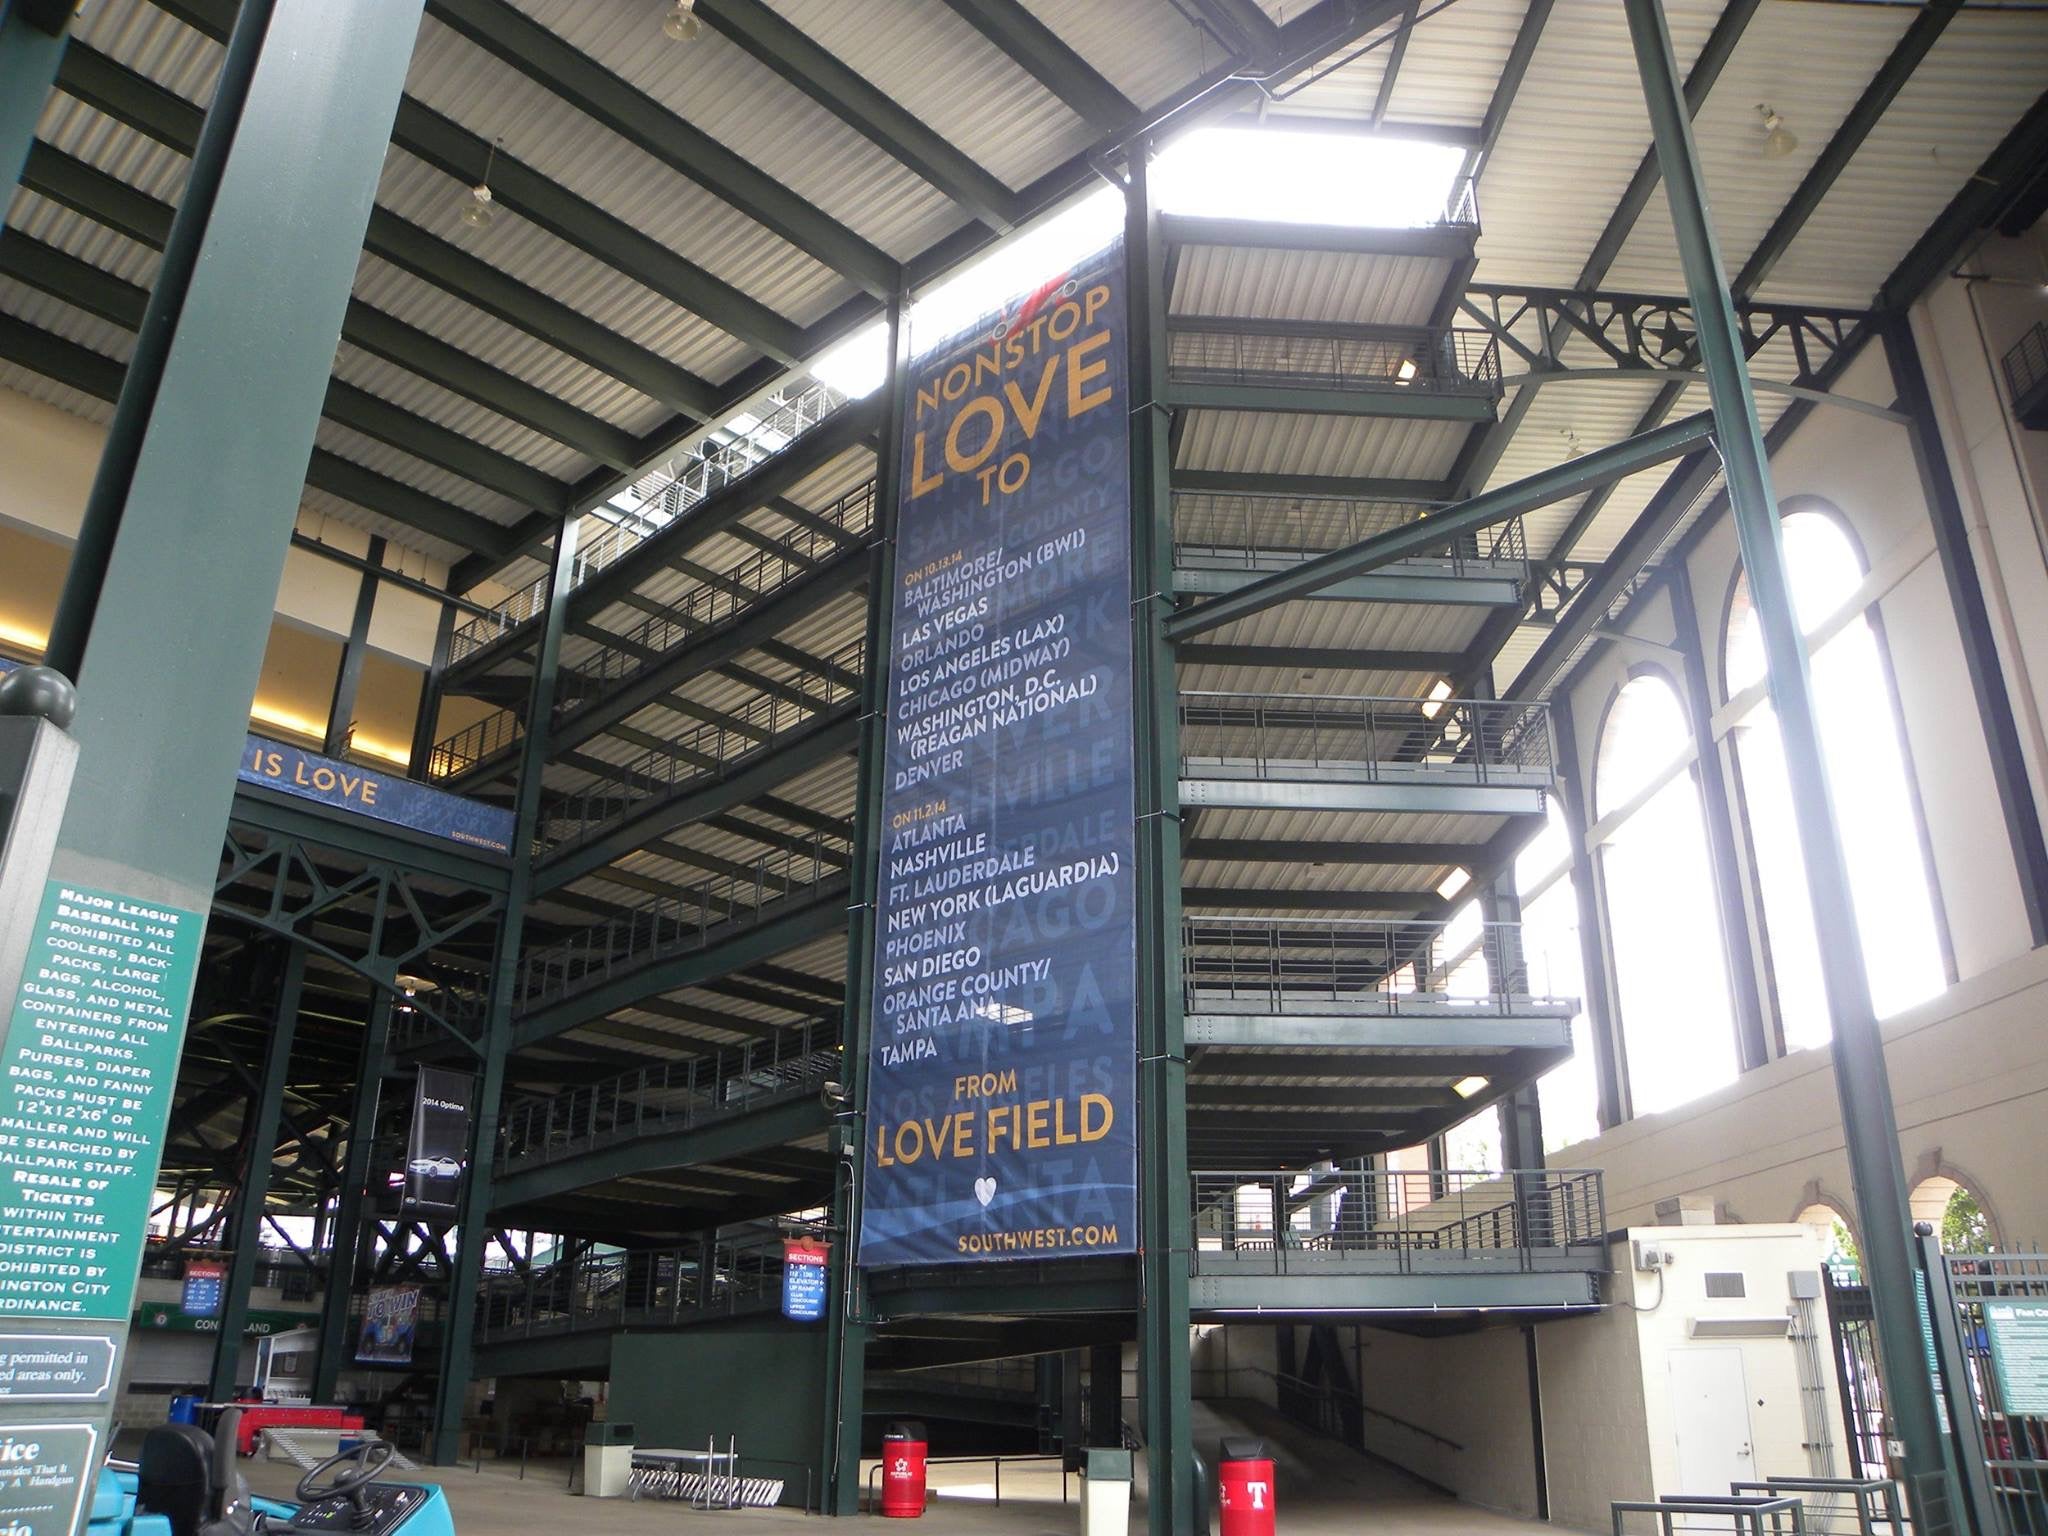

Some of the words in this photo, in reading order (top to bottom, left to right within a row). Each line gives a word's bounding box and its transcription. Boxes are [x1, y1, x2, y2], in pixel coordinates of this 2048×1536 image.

[916, 285, 1110, 421] NONSTOP
[912, 329, 1112, 499] LOVE
[976, 452, 1030, 506] TO
[905, 571, 922, 586] ON
[925, 550, 963, 577] 10.13.14
[905, 547, 1002, 608] BALTIMORE/
[917, 552, 1032, 618] WASHINGTON
[1037, 528, 1085, 565] (BWI)
[902, 624, 931, 649] LAS
[933, 597, 988, 633] VEGAS
[900, 672, 930, 697] LOS
[933, 637, 1010, 683] ANGELES
[1015, 614, 1064, 649] (LAX)
[901, 623, 984, 672] ORLANDO
[898, 674, 976, 720] CHICAGO
[980, 637, 1069, 689] (MIDWAY)
[897, 685, 1020, 745] WASHINGTON,
[1024, 669, 1061, 697] D.C.
[910, 715, 986, 760] (REAGAN
[992, 674, 1097, 730] NATIONAL)
[253, 749, 283, 777] IS
[296, 762, 378, 804] LOVE
[895, 749, 964, 791] DENVER
[893, 812, 911, 829] ON
[913, 800, 946, 821] 11.2.14
[452, 831, 506, 850] SOUTHWEST.COM
[891, 814, 966, 854] ATLANTA
[890, 833, 986, 879] NASHVILLE
[889, 884, 910, 906] FT.
[914, 846, 1035, 899] LAUDERDALE
[60, 888, 114, 910] MAJOR
[118, 901, 179, 924] LEAGUE
[888, 904, 927, 933] NEW
[930, 888, 981, 920] YORK
[985, 852, 1120, 908] (LAGUARDIA)
[57, 904, 139, 932] BASEBALL
[146, 925, 175, 939] HAS
[46, 936, 122, 962] COOLERS,
[128, 953, 172, 969] BACK-
[49, 921, 143, 948] PROHIBITED
[146, 942, 175, 955] ALL
[886, 921, 966, 961] PHOENIX
[52, 954, 107, 974] PACKS,
[112, 966, 161, 984] LARGE
[884, 962, 917, 988] SAN
[921, 946, 980, 977] DIEGO
[24, 982, 81, 1002] GLASS,
[86, 994, 120, 1008] AND
[124, 1000, 172, 1018] METAL
[39, 968, 86, 987] BAGS,
[91, 978, 165, 1002] ALCOHOL,
[883, 980, 957, 1015] ORANGE
[961, 958, 1051, 997] COUNTY/
[22, 999, 122, 1025] CONTAINERS
[128, 1018, 169, 1033] FROM
[896, 1005, 952, 1035] SANTA
[955, 995, 996, 1021] ANA
[35, 1018, 115, 1039] ENTERING
[120, 1033, 149, 1046] ALL
[41, 1034, 138, 1060] BALLPARKS.
[19, 1049, 89, 1071] PURSES,
[95, 1061, 152, 1079] DIAPER
[881, 1036, 937, 1066] TAMPA
[9, 1066, 58, 1084] BAGS,
[64, 1074, 98, 1087] AND
[104, 1079, 154, 1095] FANNY
[955, 1069, 1017, 1100] FROM
[14, 1084, 67, 1100] PACKS
[72, 1092, 118, 1106] MUST
[122, 1099, 142, 1111] BE
[422, 1097, 439, 1106] 2014
[440, 1100, 464, 1111] Optima
[73, 1126, 107, 1139] AND
[113, 1131, 151, 1145] WILL
[111, 1114, 133, 1126] OR
[877, 1111, 975, 1168] LOVE
[988, 1093, 1114, 1155] FIELD
[25, 1137, 113, 1156] SEARCHED
[118, 1149, 138, 1160] BY
[13, 1170, 82, 1189] RESALE
[87, 1179, 109, 1191] OF
[83, 1162, 137, 1177] STAFF.
[22, 1188, 95, 1207] TICKETS
[3, 1207, 66, 1222] WITHIN
[73, 1213, 105, 1225] THE
[0, 1224, 120, 1244] TERTAINMENT
[958, 1225, 1118, 1252] SOUTHWEST.COM
[80, 1248, 96, 1260] IS
[788, 1253, 824, 1262] SECTIONS
[86, 1266, 107, 1278] BY
[789, 1278, 818, 1286] ELEVATOR
[72, 1282, 111, 1296] CITY
[9, 1351, 74, 1367] permitted
[76, 1352, 89, 1364] in
[17, 1370, 52, 1380] areas
[54, 1368, 86, 1384] only.
[28, 1475, 74, 1487] Handgun
[34, 1464, 57, 1474] That
[1247, 1481, 1267, 1509] T
